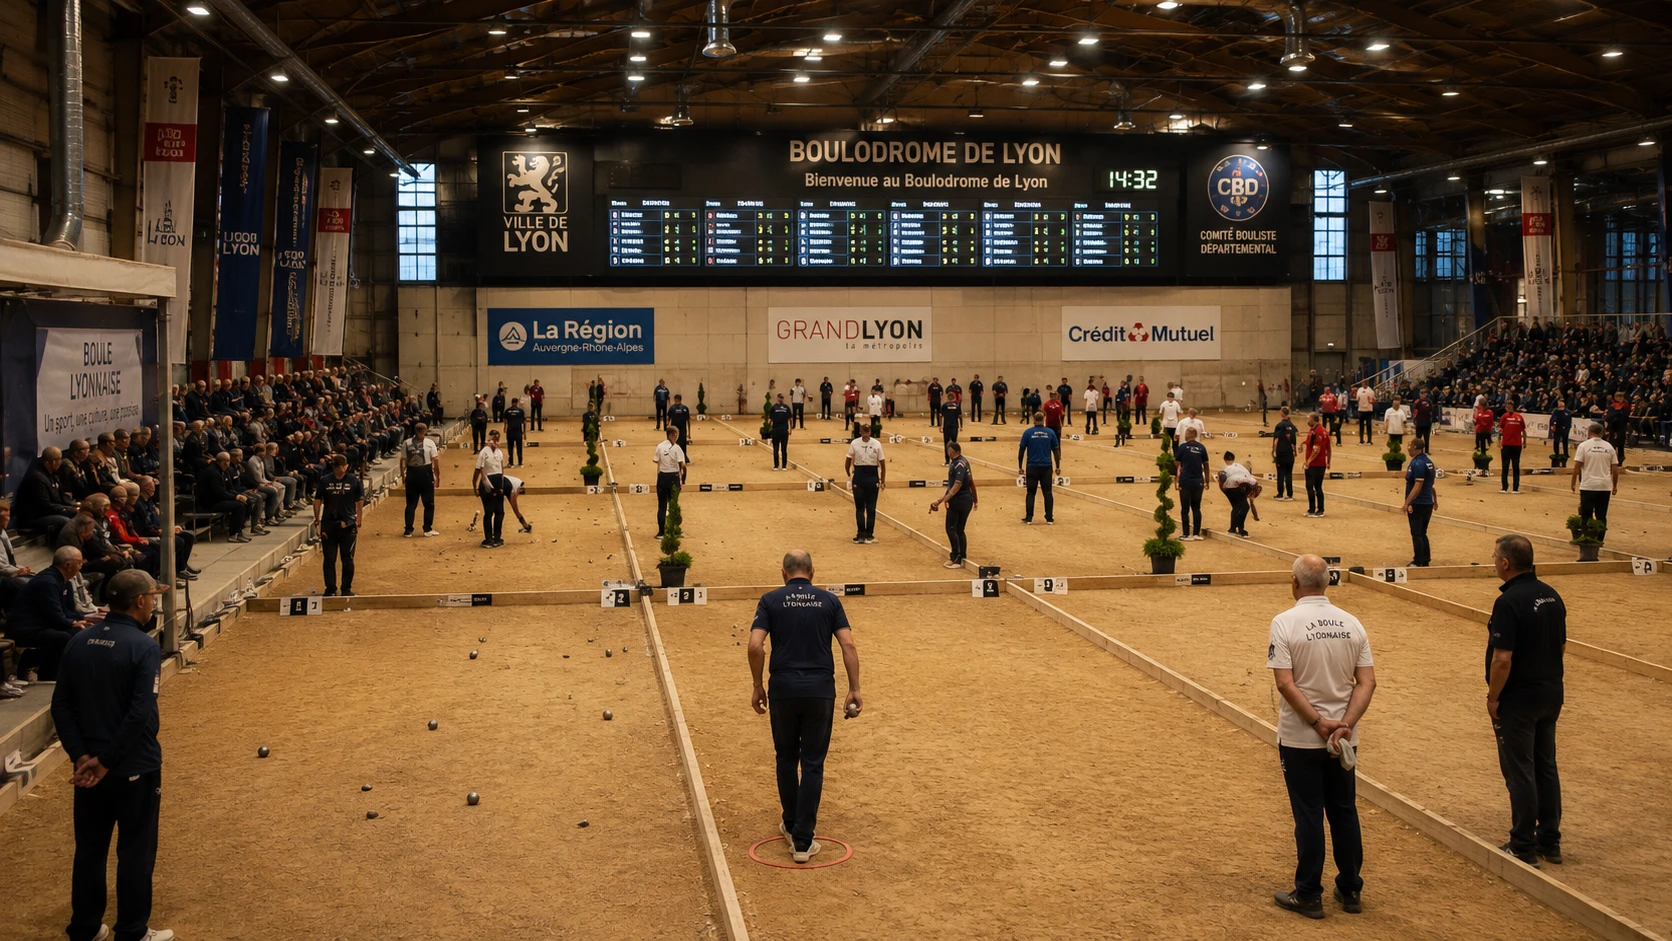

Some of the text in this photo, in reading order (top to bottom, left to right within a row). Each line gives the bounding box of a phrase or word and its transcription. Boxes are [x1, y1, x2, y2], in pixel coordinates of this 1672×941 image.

[789, 140, 1061, 164] BOULODROME DE LYON
[805, 173, 1048, 191] Bienvenue au Boulodrome de Lyon
[1109, 170, 1158, 189] 14:32
[1217, 178, 1259, 196] CBD
[503, 216, 568, 229] VILLE DE
[503, 231, 568, 253] LYON
[1200, 227, 1277, 241] COMITÉ BOULISTE
[222, 243, 260, 256] LYON
[1200, 243, 1277, 254] DÉPARTEMENTAL
[533, 320, 642, 344] La Région
[1068, 325, 1214, 343] Crédit Mutuel
[83, 342, 113, 366] BOULE
[70, 371, 121, 400] LYONNAISE
